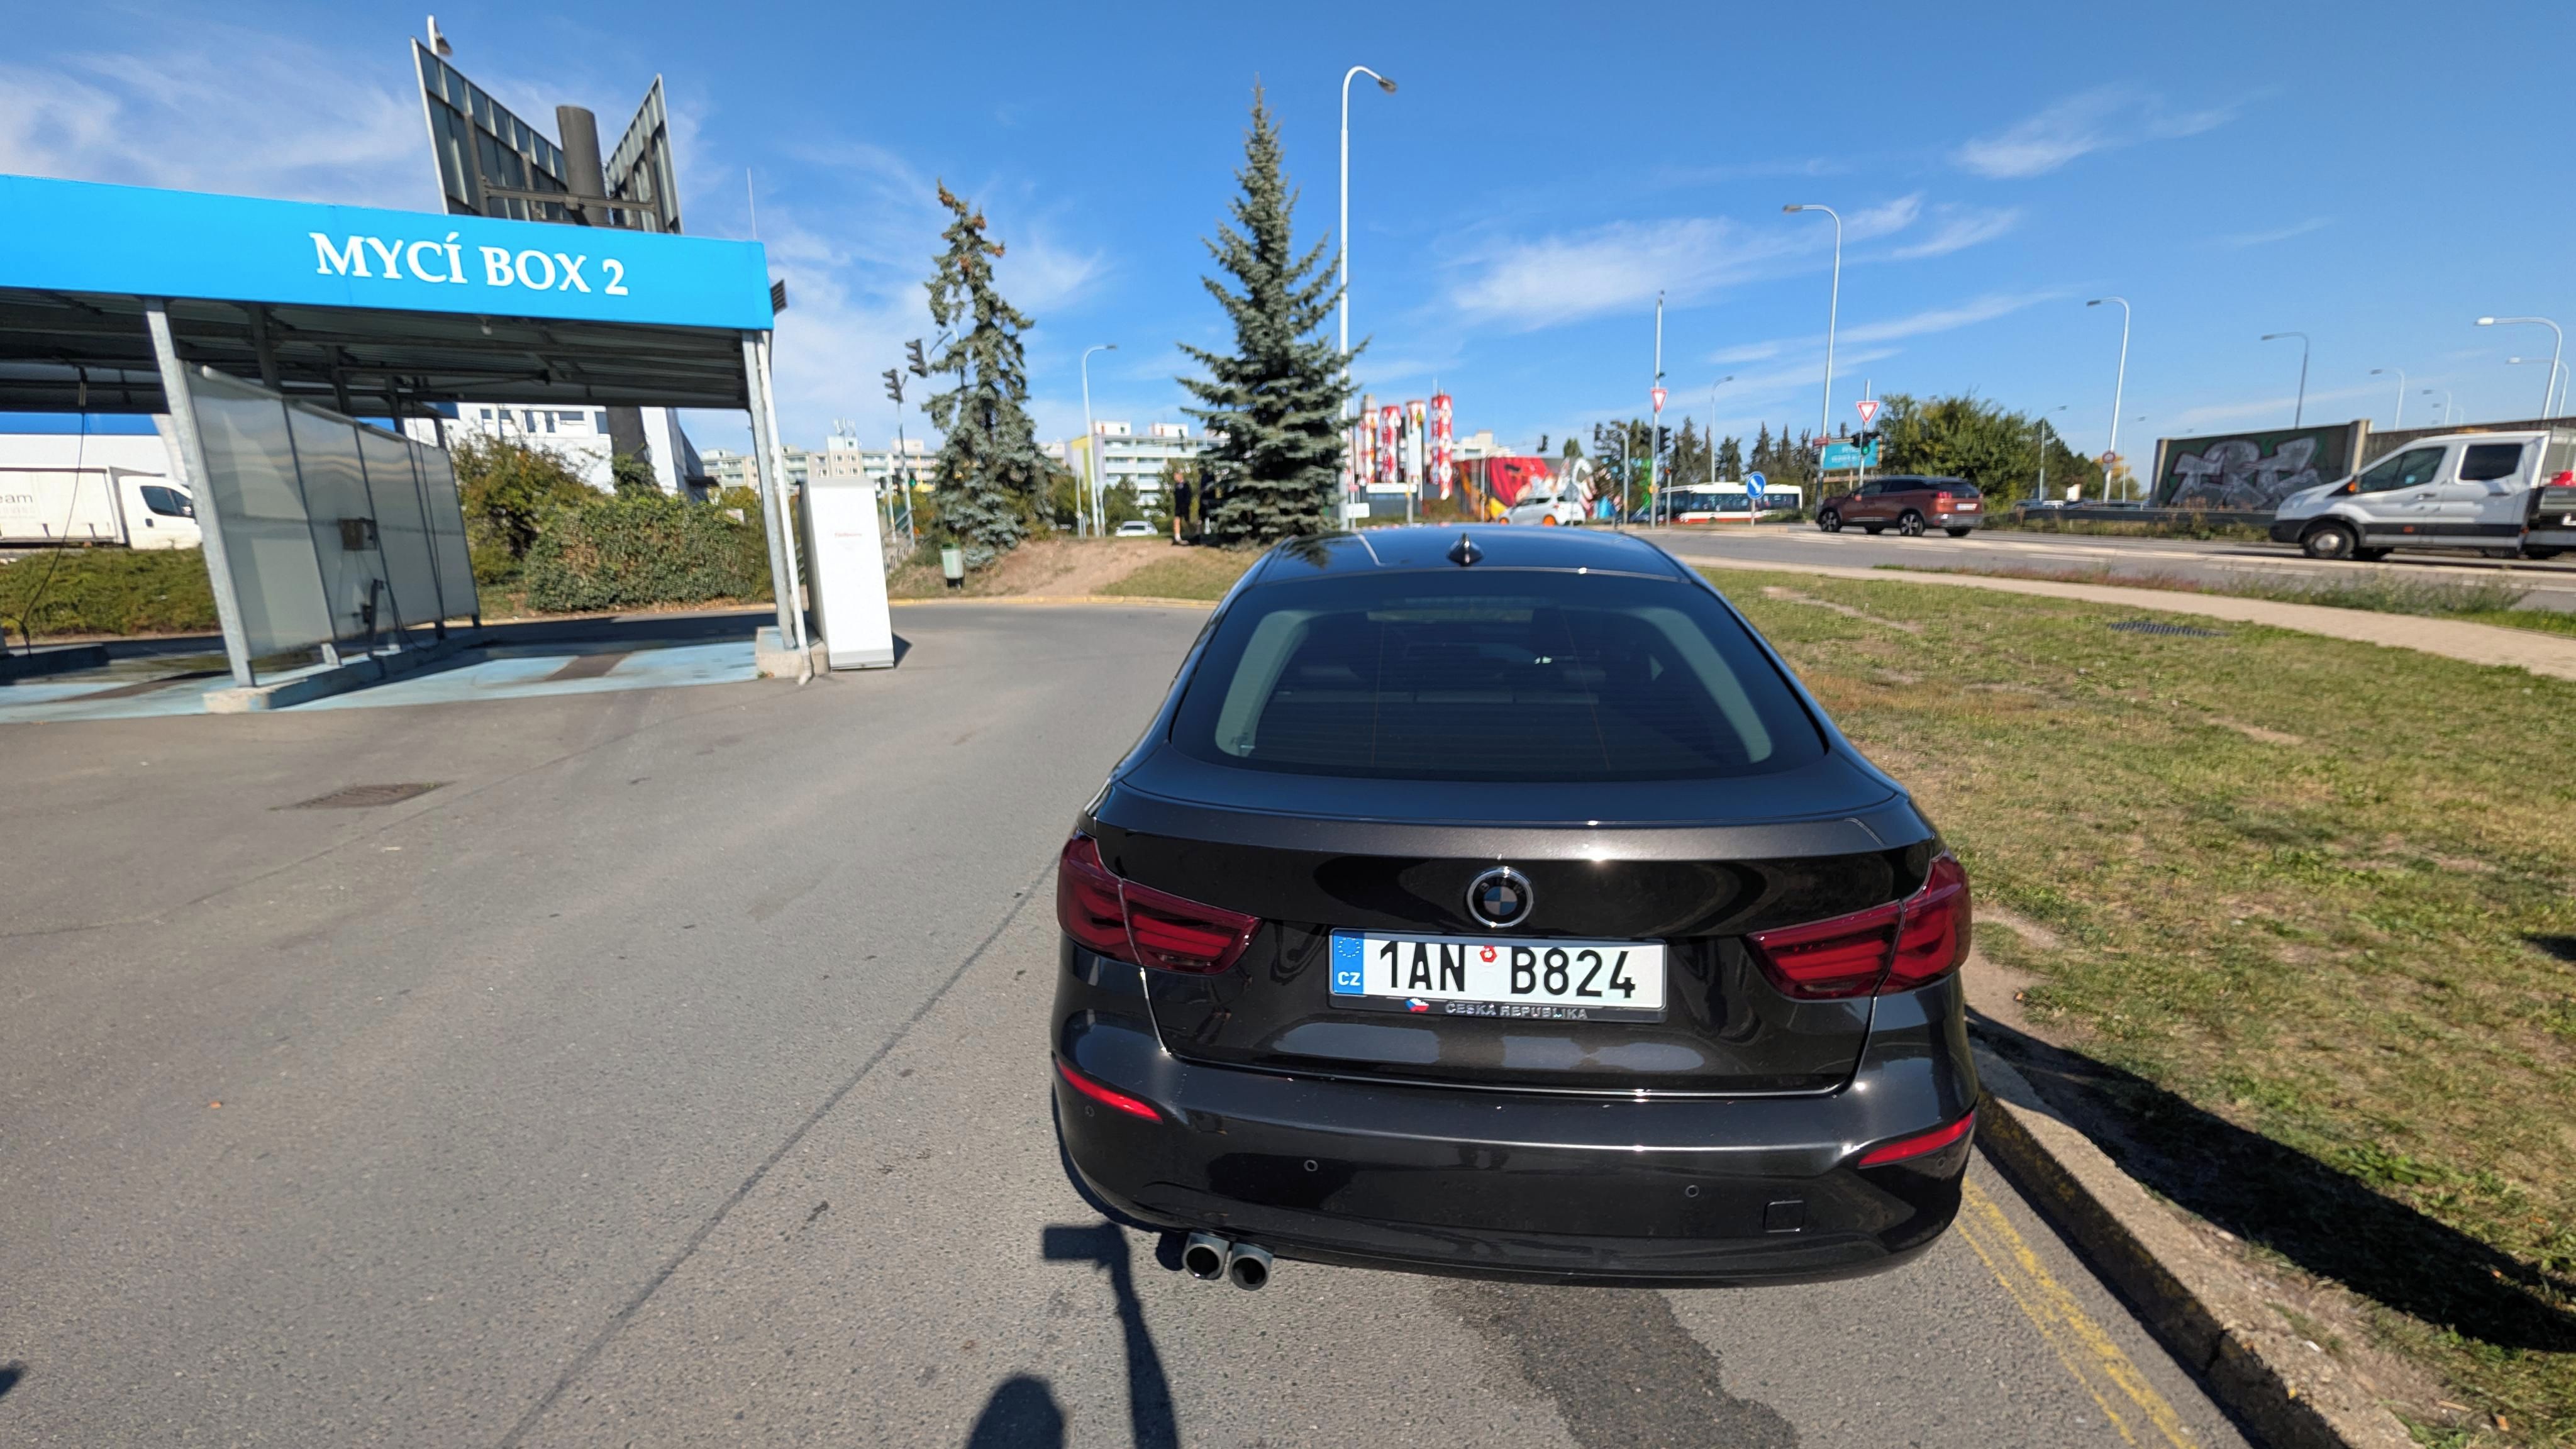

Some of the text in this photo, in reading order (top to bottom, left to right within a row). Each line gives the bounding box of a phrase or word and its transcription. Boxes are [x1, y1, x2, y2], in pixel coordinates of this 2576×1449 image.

[308, 231, 629, 296] MYCÍ BOX 2
[1338, 971, 1361, 986] CZ
[1380, 941, 1635, 999] 1AN B824
[1445, 1001, 1588, 1020] ČESKÁ REPUBLIKA
